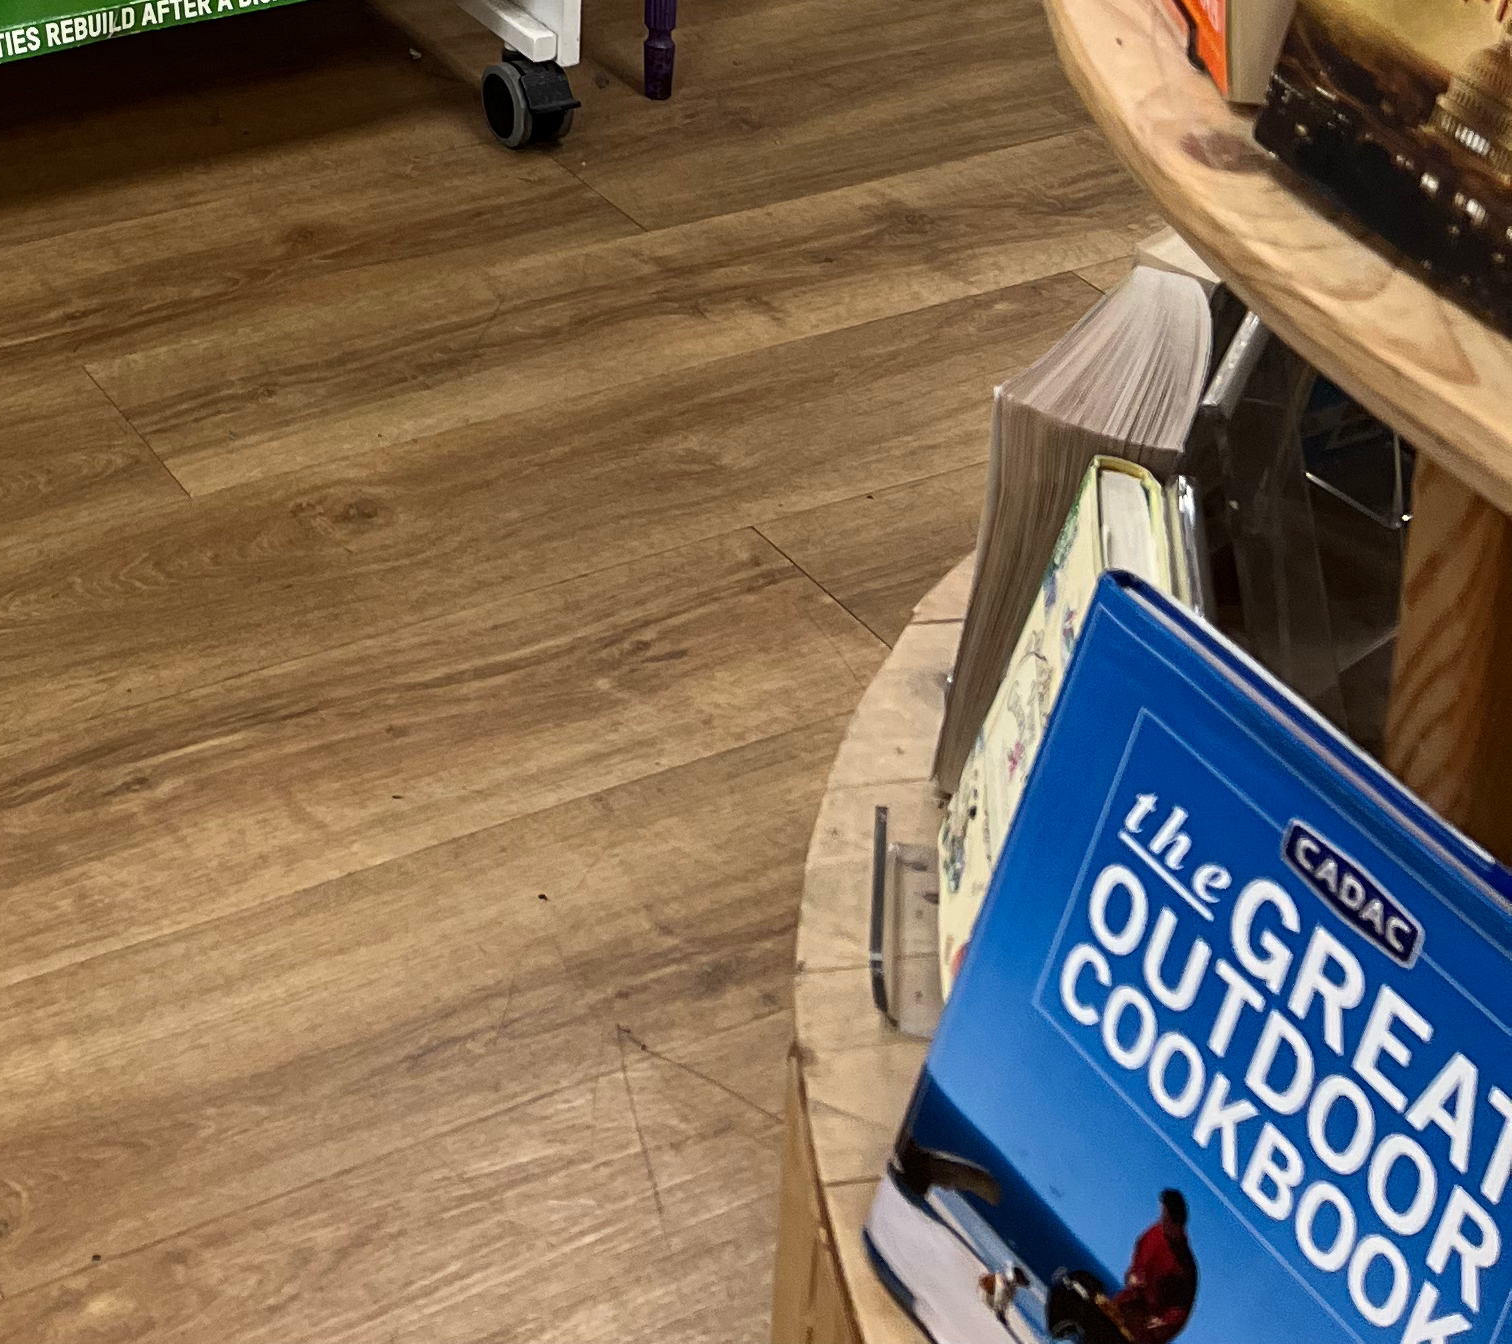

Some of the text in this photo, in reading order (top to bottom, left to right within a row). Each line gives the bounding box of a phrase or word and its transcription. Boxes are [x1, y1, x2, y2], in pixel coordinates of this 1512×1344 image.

[47, 6, 135, 48] REBUILD
[1089, 864, 1501, 1313] OUTDOOR
[1123, 792, 1512, 1205] the GREAT
[1289, 835, 1412, 954] CADAC
[1062, 943, 1473, 1344] COOKBOOK
